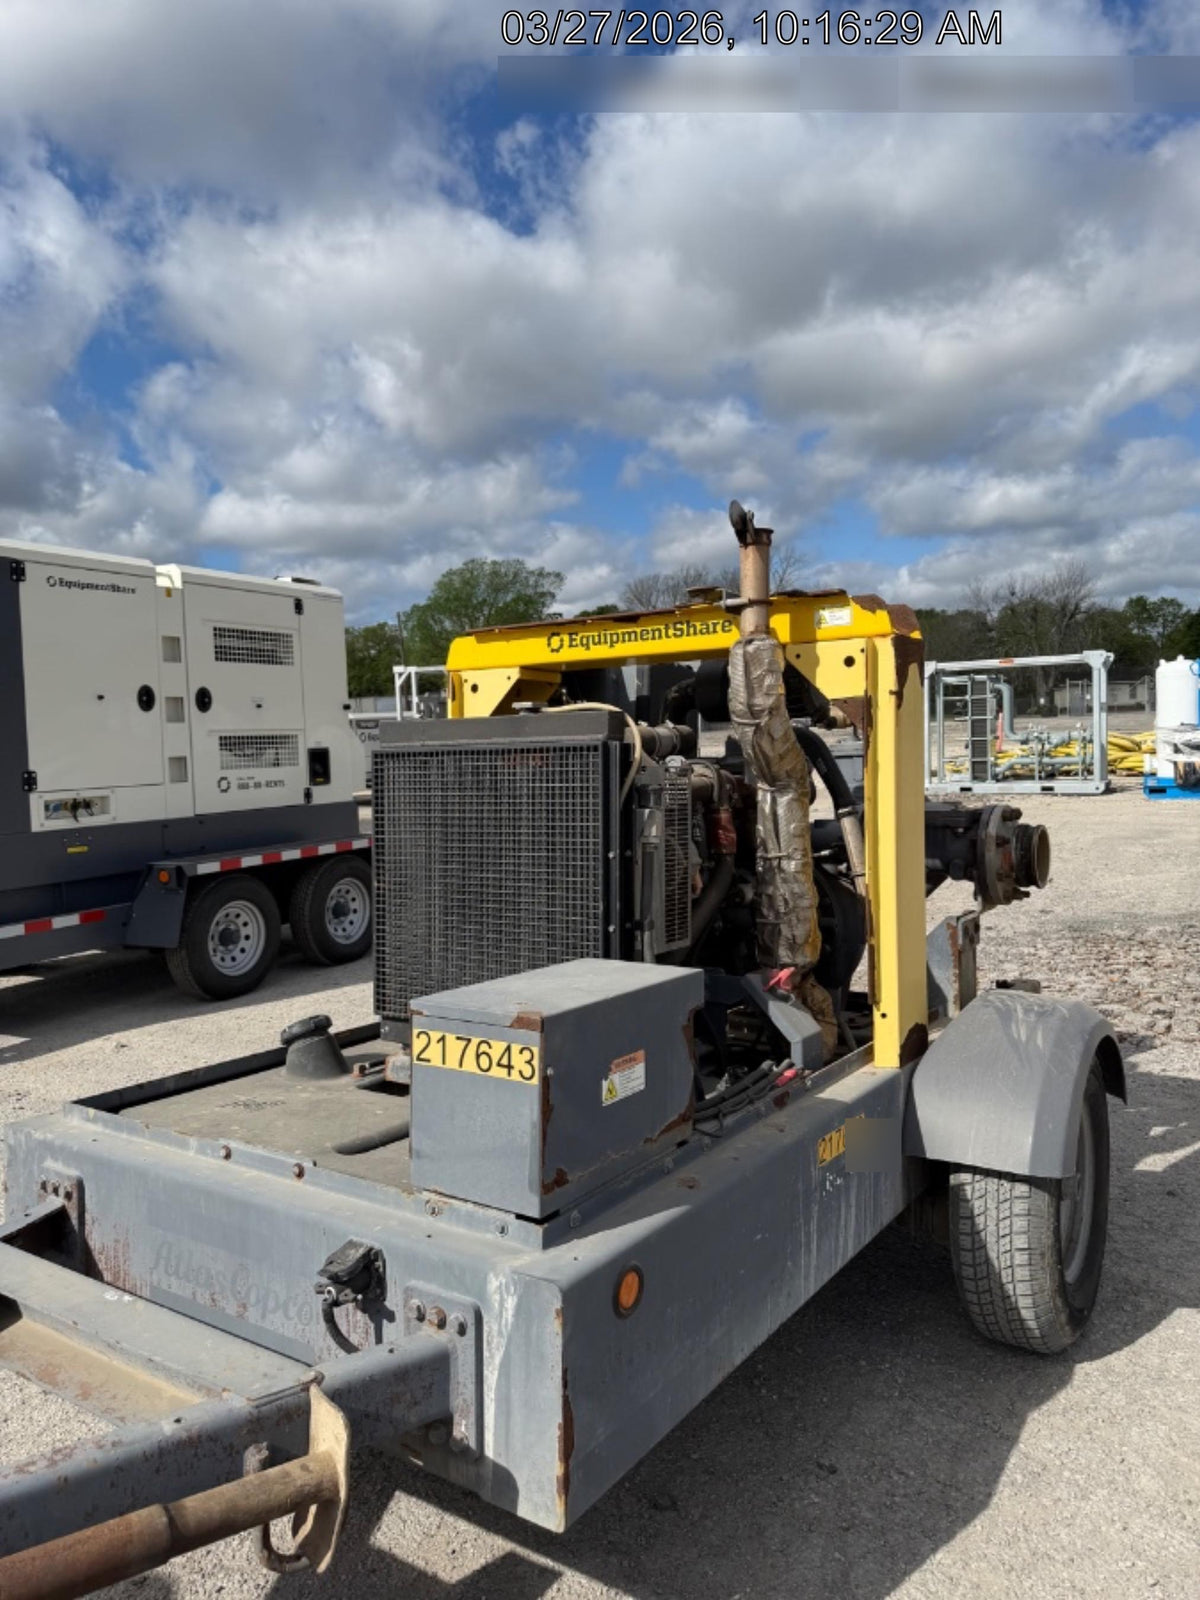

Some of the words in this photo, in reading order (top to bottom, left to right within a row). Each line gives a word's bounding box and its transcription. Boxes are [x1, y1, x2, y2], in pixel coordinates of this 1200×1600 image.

[58, 577, 136, 594] EquipmentShare
[568, 619, 733, 651] EquipmentShare
[414, 1030, 536, 1082] 217643
